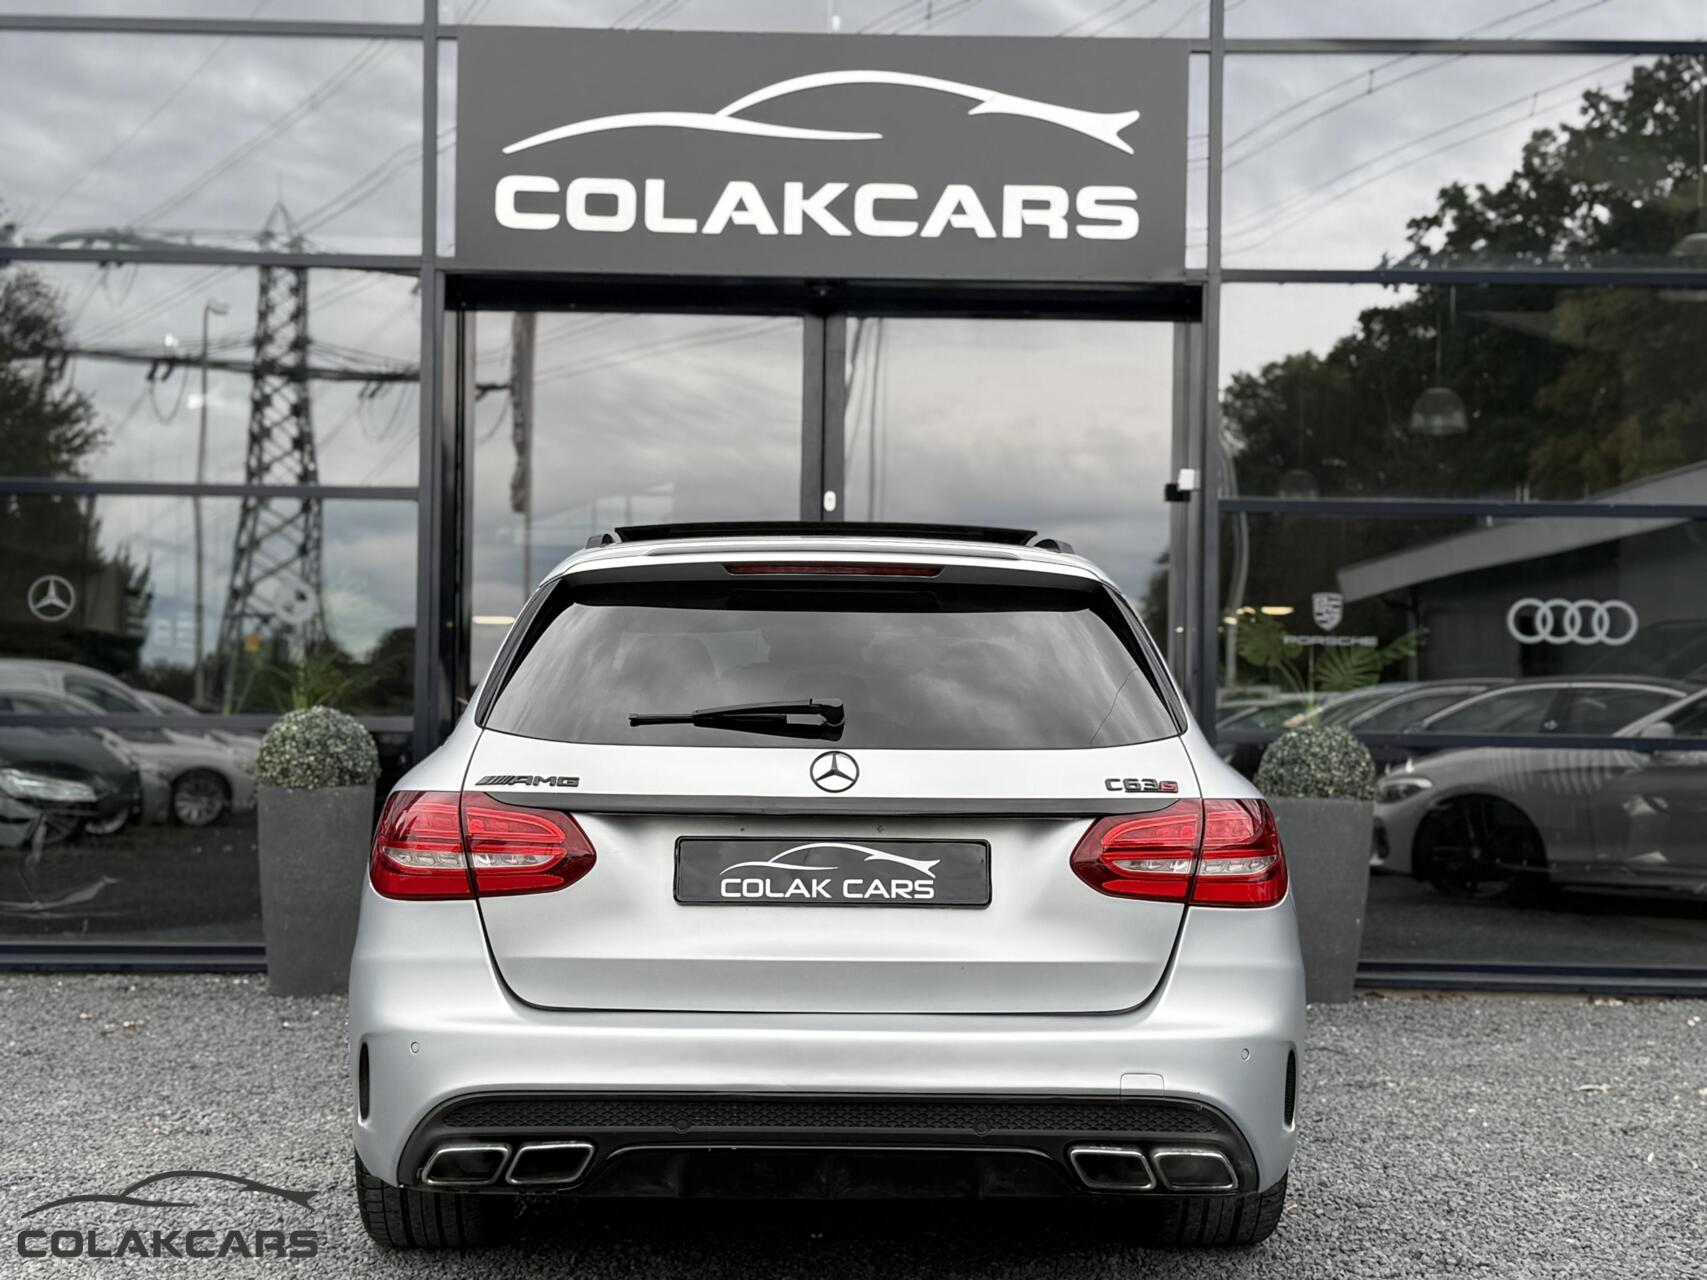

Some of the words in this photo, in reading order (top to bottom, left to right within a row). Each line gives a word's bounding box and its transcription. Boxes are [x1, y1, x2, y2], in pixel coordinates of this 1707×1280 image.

[494, 174, 1140, 240] COLAKCARS
[506, 775, 580, 787] AMG
[720, 878, 832, 898] COLAK
[842, 878, 936, 899] CARS
